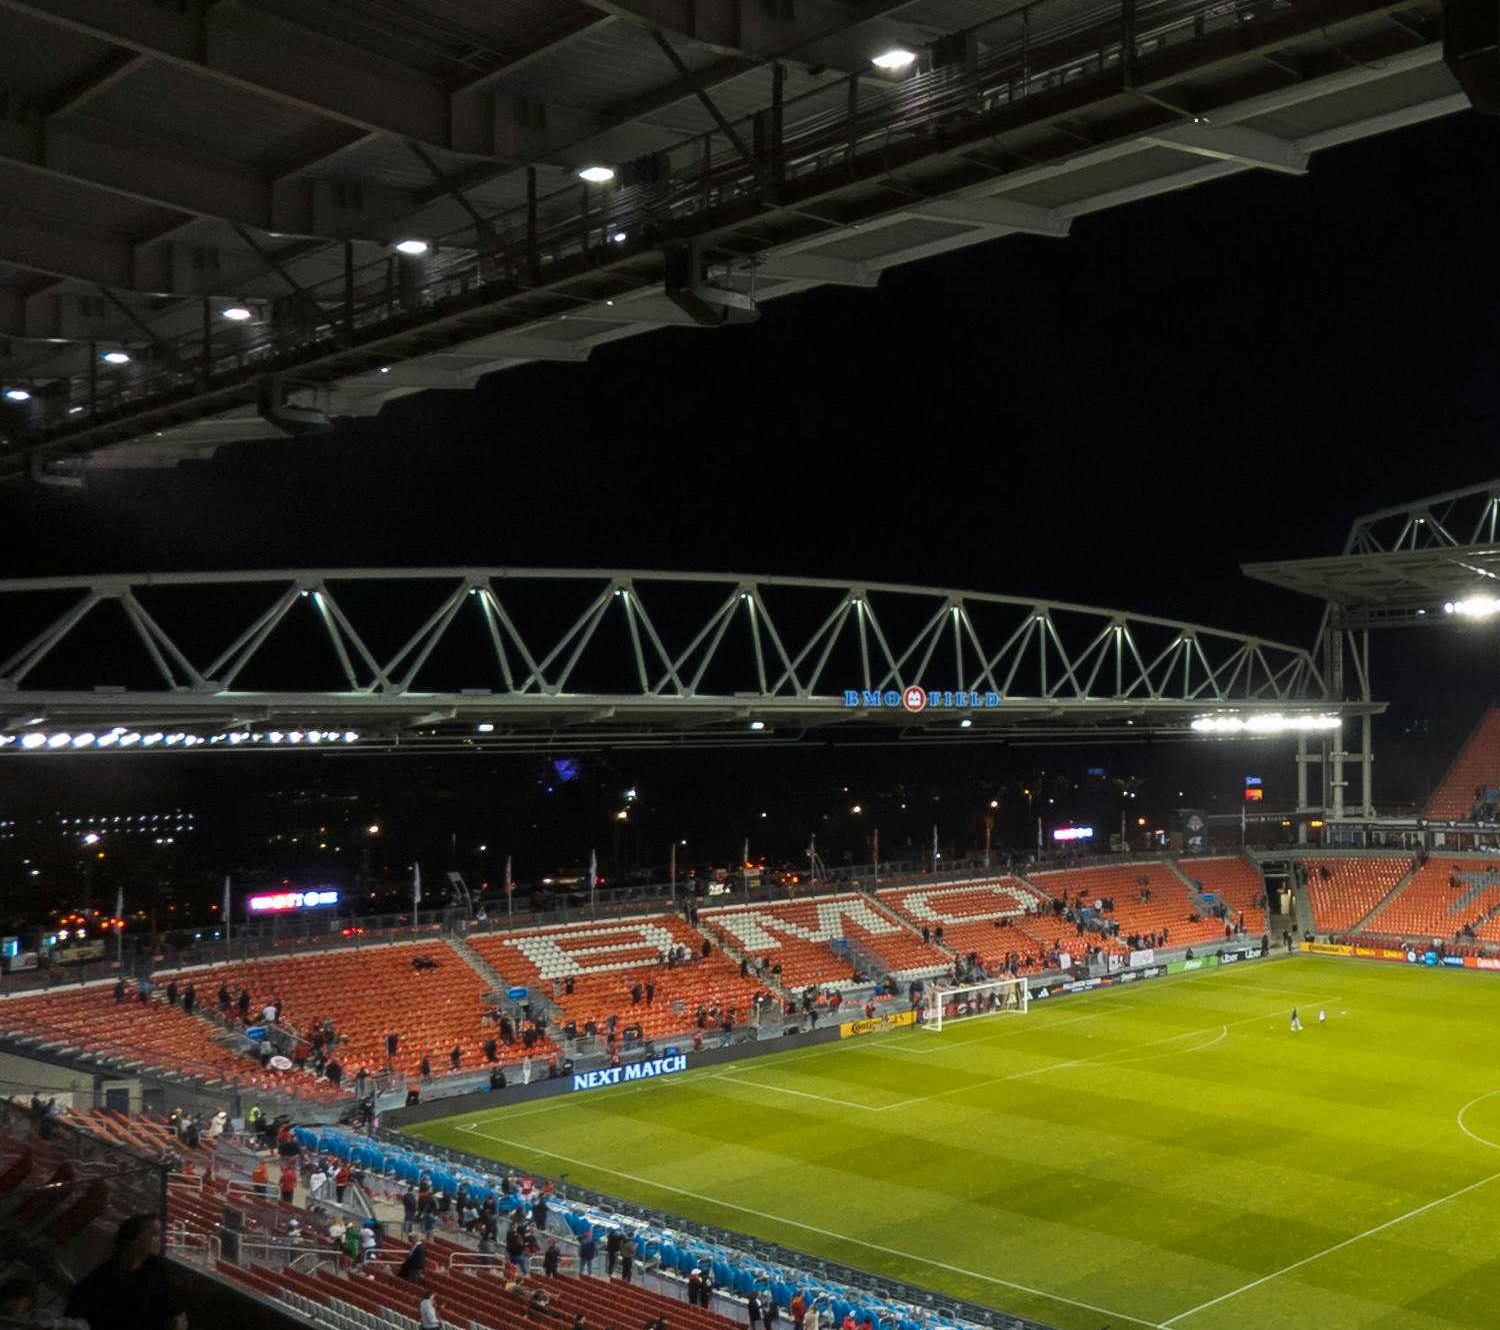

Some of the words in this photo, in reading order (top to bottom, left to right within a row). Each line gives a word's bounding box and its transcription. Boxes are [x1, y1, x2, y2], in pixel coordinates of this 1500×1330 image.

[844, 690, 900, 707] BMO
[929, 691, 1000, 707] FIELD
[1245, 945, 1262, 958] Uber
[573, 1067, 622, 1091] NEXT
[624, 1055, 687, 1081] MATCH
